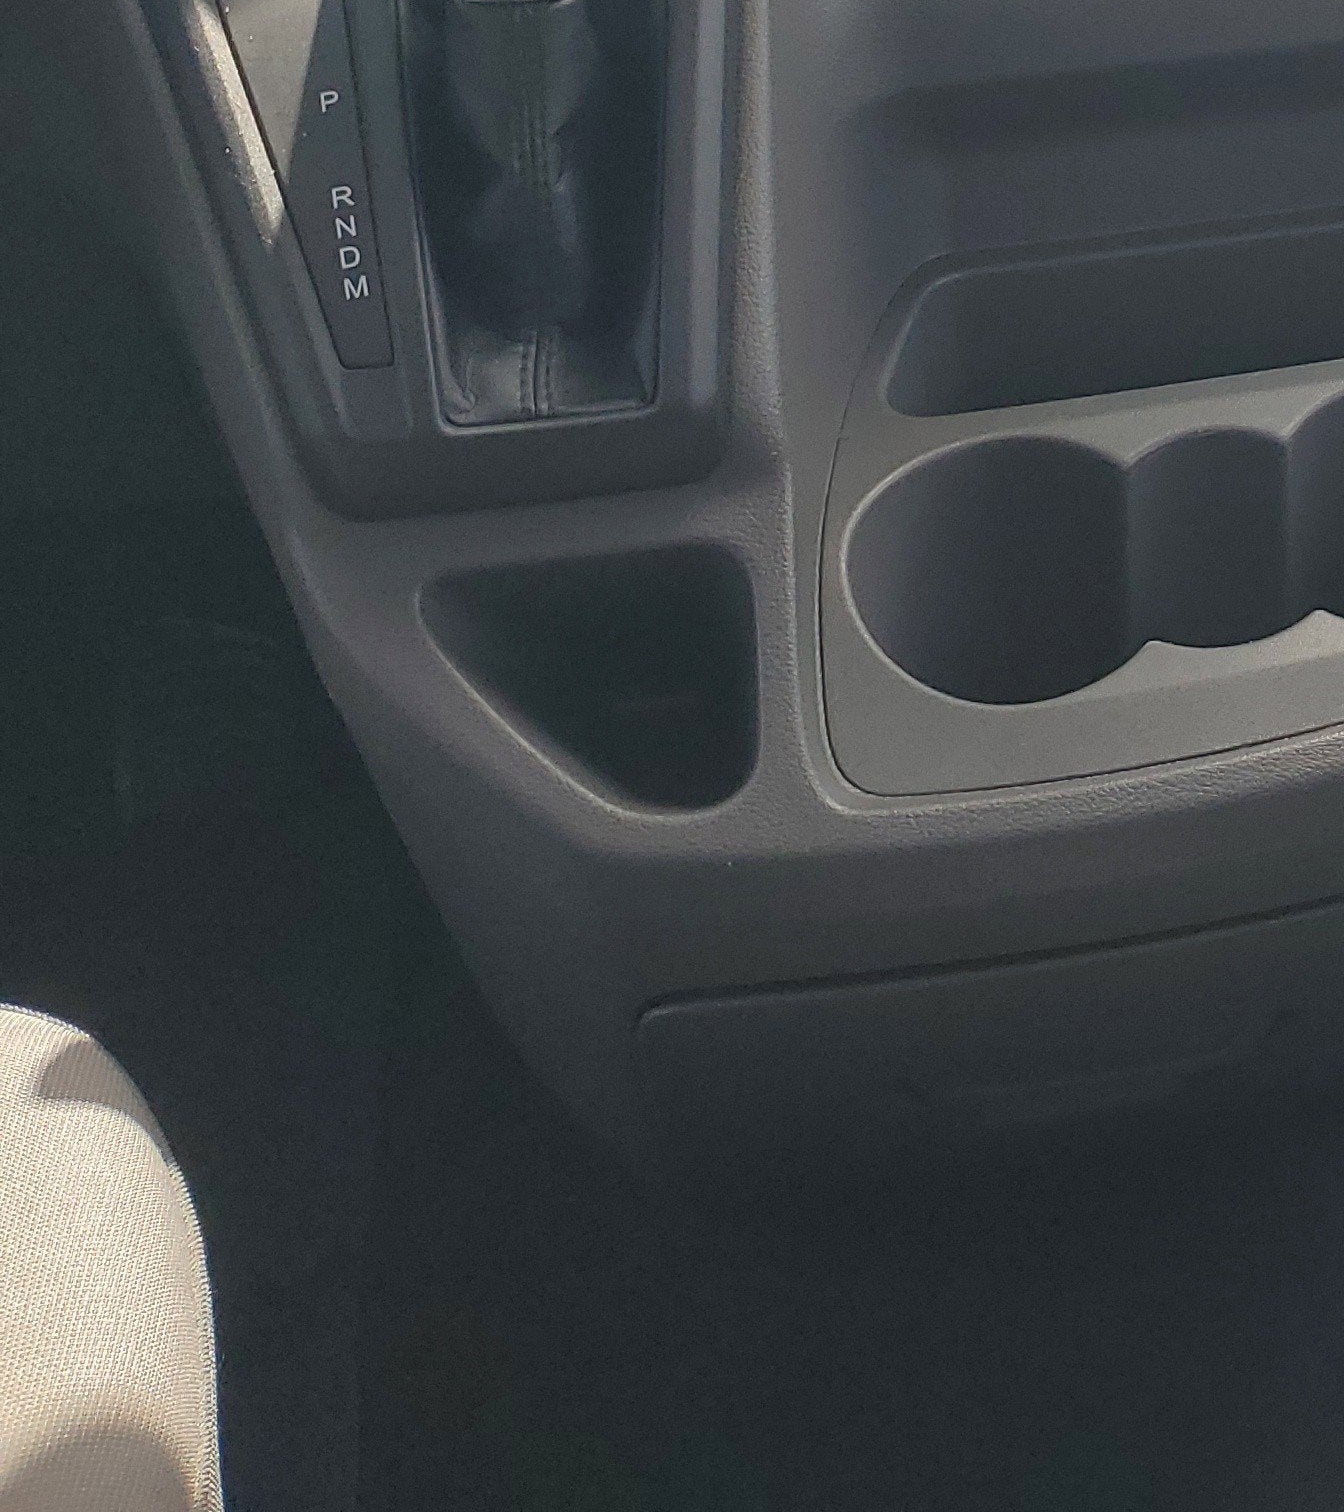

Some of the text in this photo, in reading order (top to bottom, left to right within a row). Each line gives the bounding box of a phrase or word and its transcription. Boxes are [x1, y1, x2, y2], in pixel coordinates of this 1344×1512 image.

[319, 90, 339, 113] P
[331, 185, 356, 210] R
[335, 215, 358, 240] N
[338, 245, 361, 270] D
[343, 275, 371, 301] M
